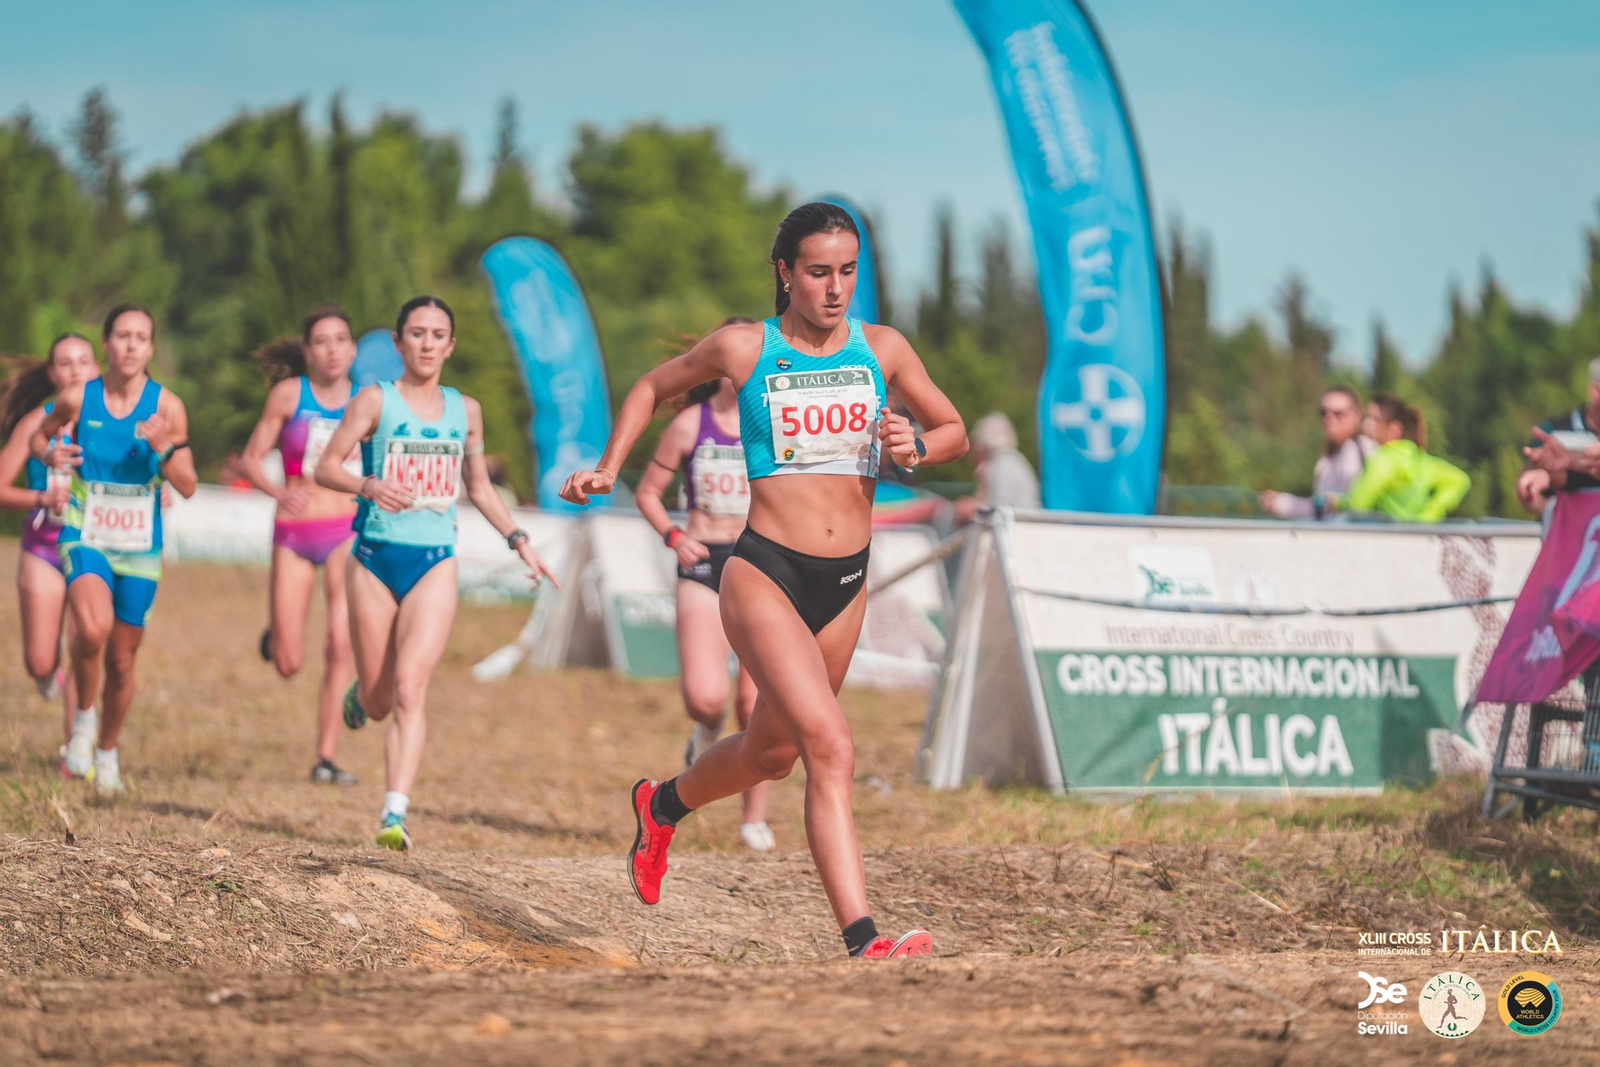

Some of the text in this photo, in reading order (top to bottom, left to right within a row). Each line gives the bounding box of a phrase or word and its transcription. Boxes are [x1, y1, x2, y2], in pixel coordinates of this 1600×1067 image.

[796, 373, 846, 386] ITÁLICA
[781, 402, 867, 437] 5008
[703, 471, 748, 496] 501
[91, 504, 146, 531] 5001
[1106, 622, 1354, 653] International Cross Country
[1057, 654, 1420, 698] CROSS INTERNACIONAL
[1157, 698, 1354, 777] ITÁLICA
